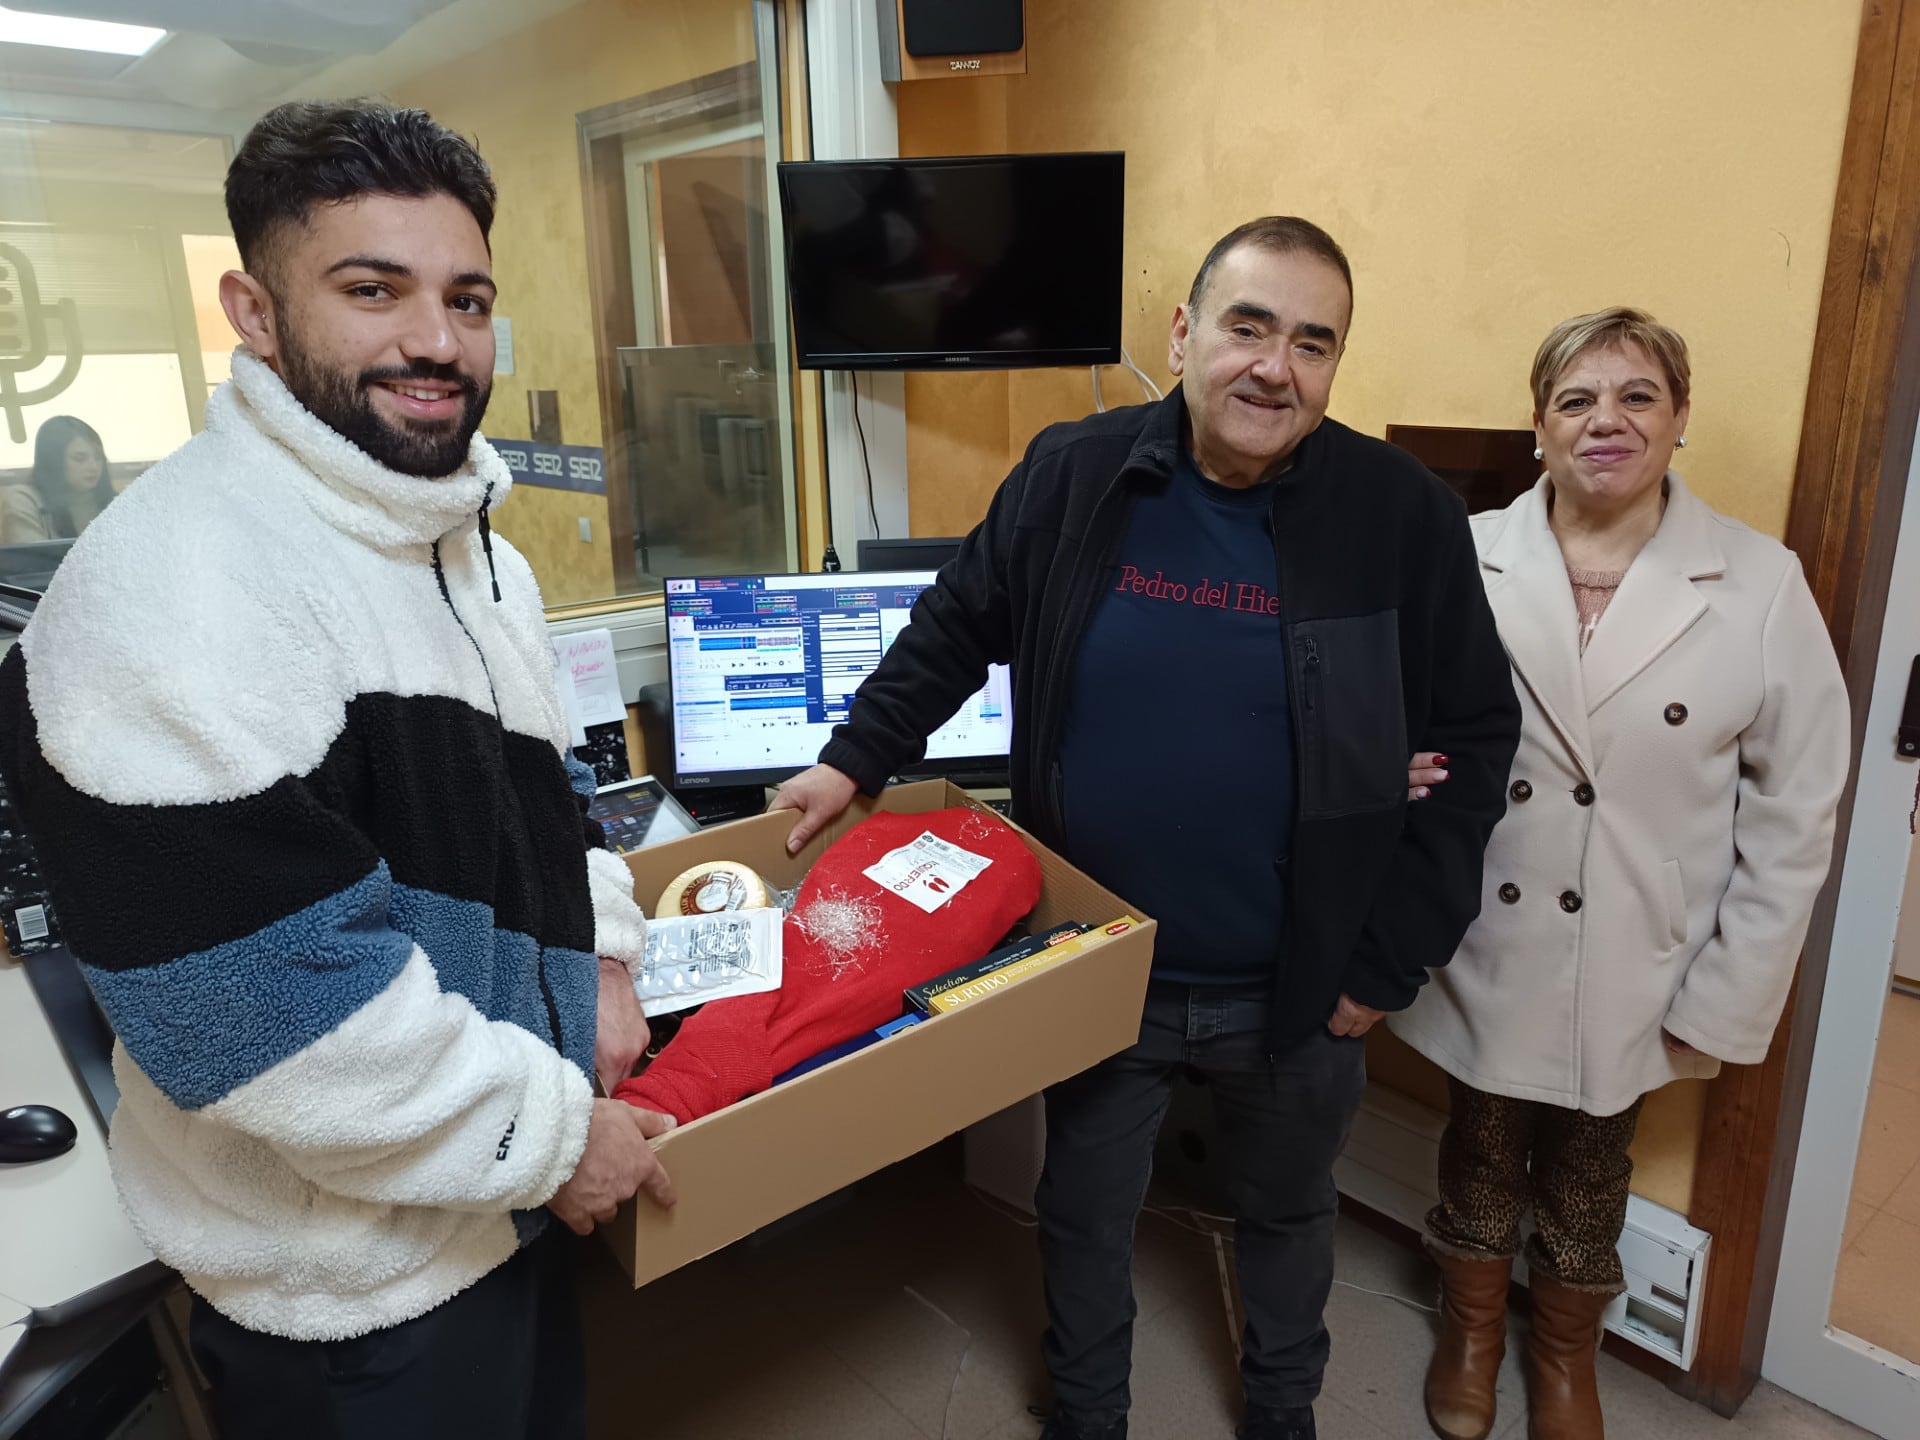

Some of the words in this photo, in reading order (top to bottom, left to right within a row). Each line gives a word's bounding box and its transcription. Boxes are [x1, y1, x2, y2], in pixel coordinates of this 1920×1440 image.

[532, 452, 563, 476] SER
[568, 456, 602, 481] SER
[1114, 565, 1188, 602] Pedro
[1192, 578, 1228, 609] del
[1232, 583, 1281, 615] Hie
[680, 777, 710, 785] Lenovo
[922, 975, 969, 1000] Selection
[944, 974, 1009, 1007] SURTIDO
